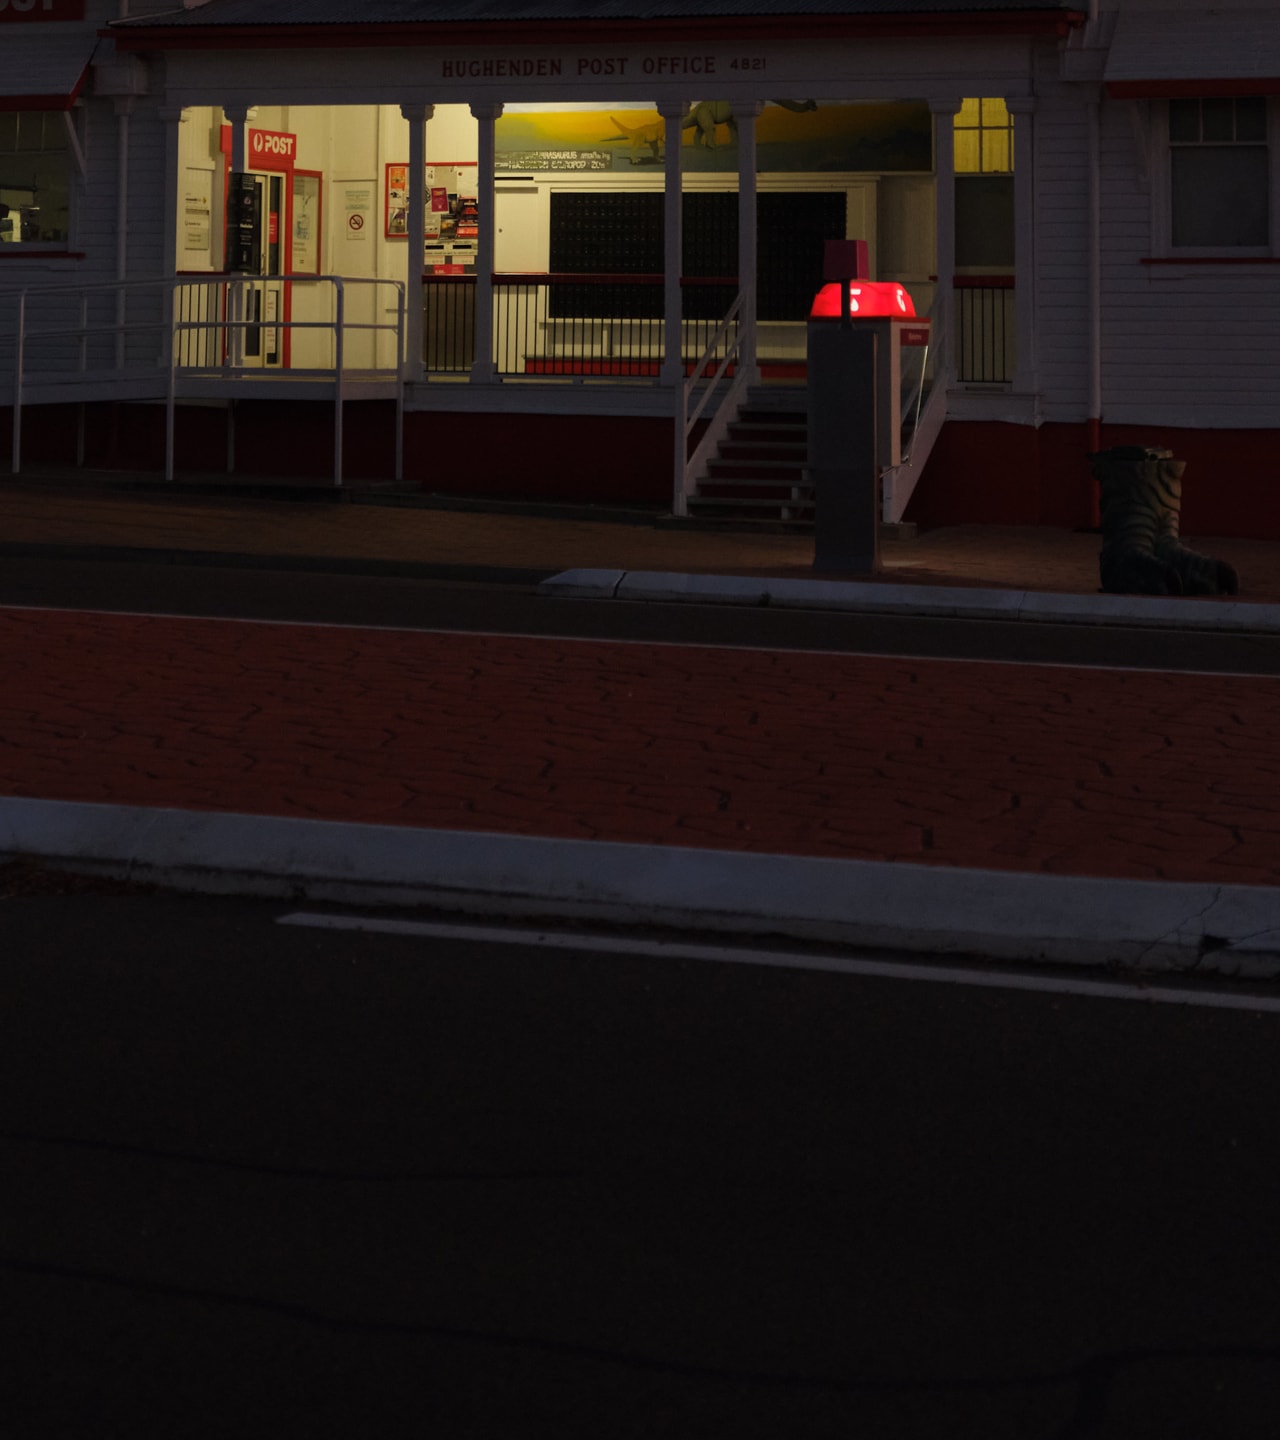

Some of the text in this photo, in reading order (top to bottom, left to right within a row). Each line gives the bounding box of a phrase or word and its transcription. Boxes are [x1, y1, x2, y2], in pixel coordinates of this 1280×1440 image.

[441, 56, 767, 78] HUGHENDEN POST OFFICE 4821
[264, 135, 294, 155] POST
